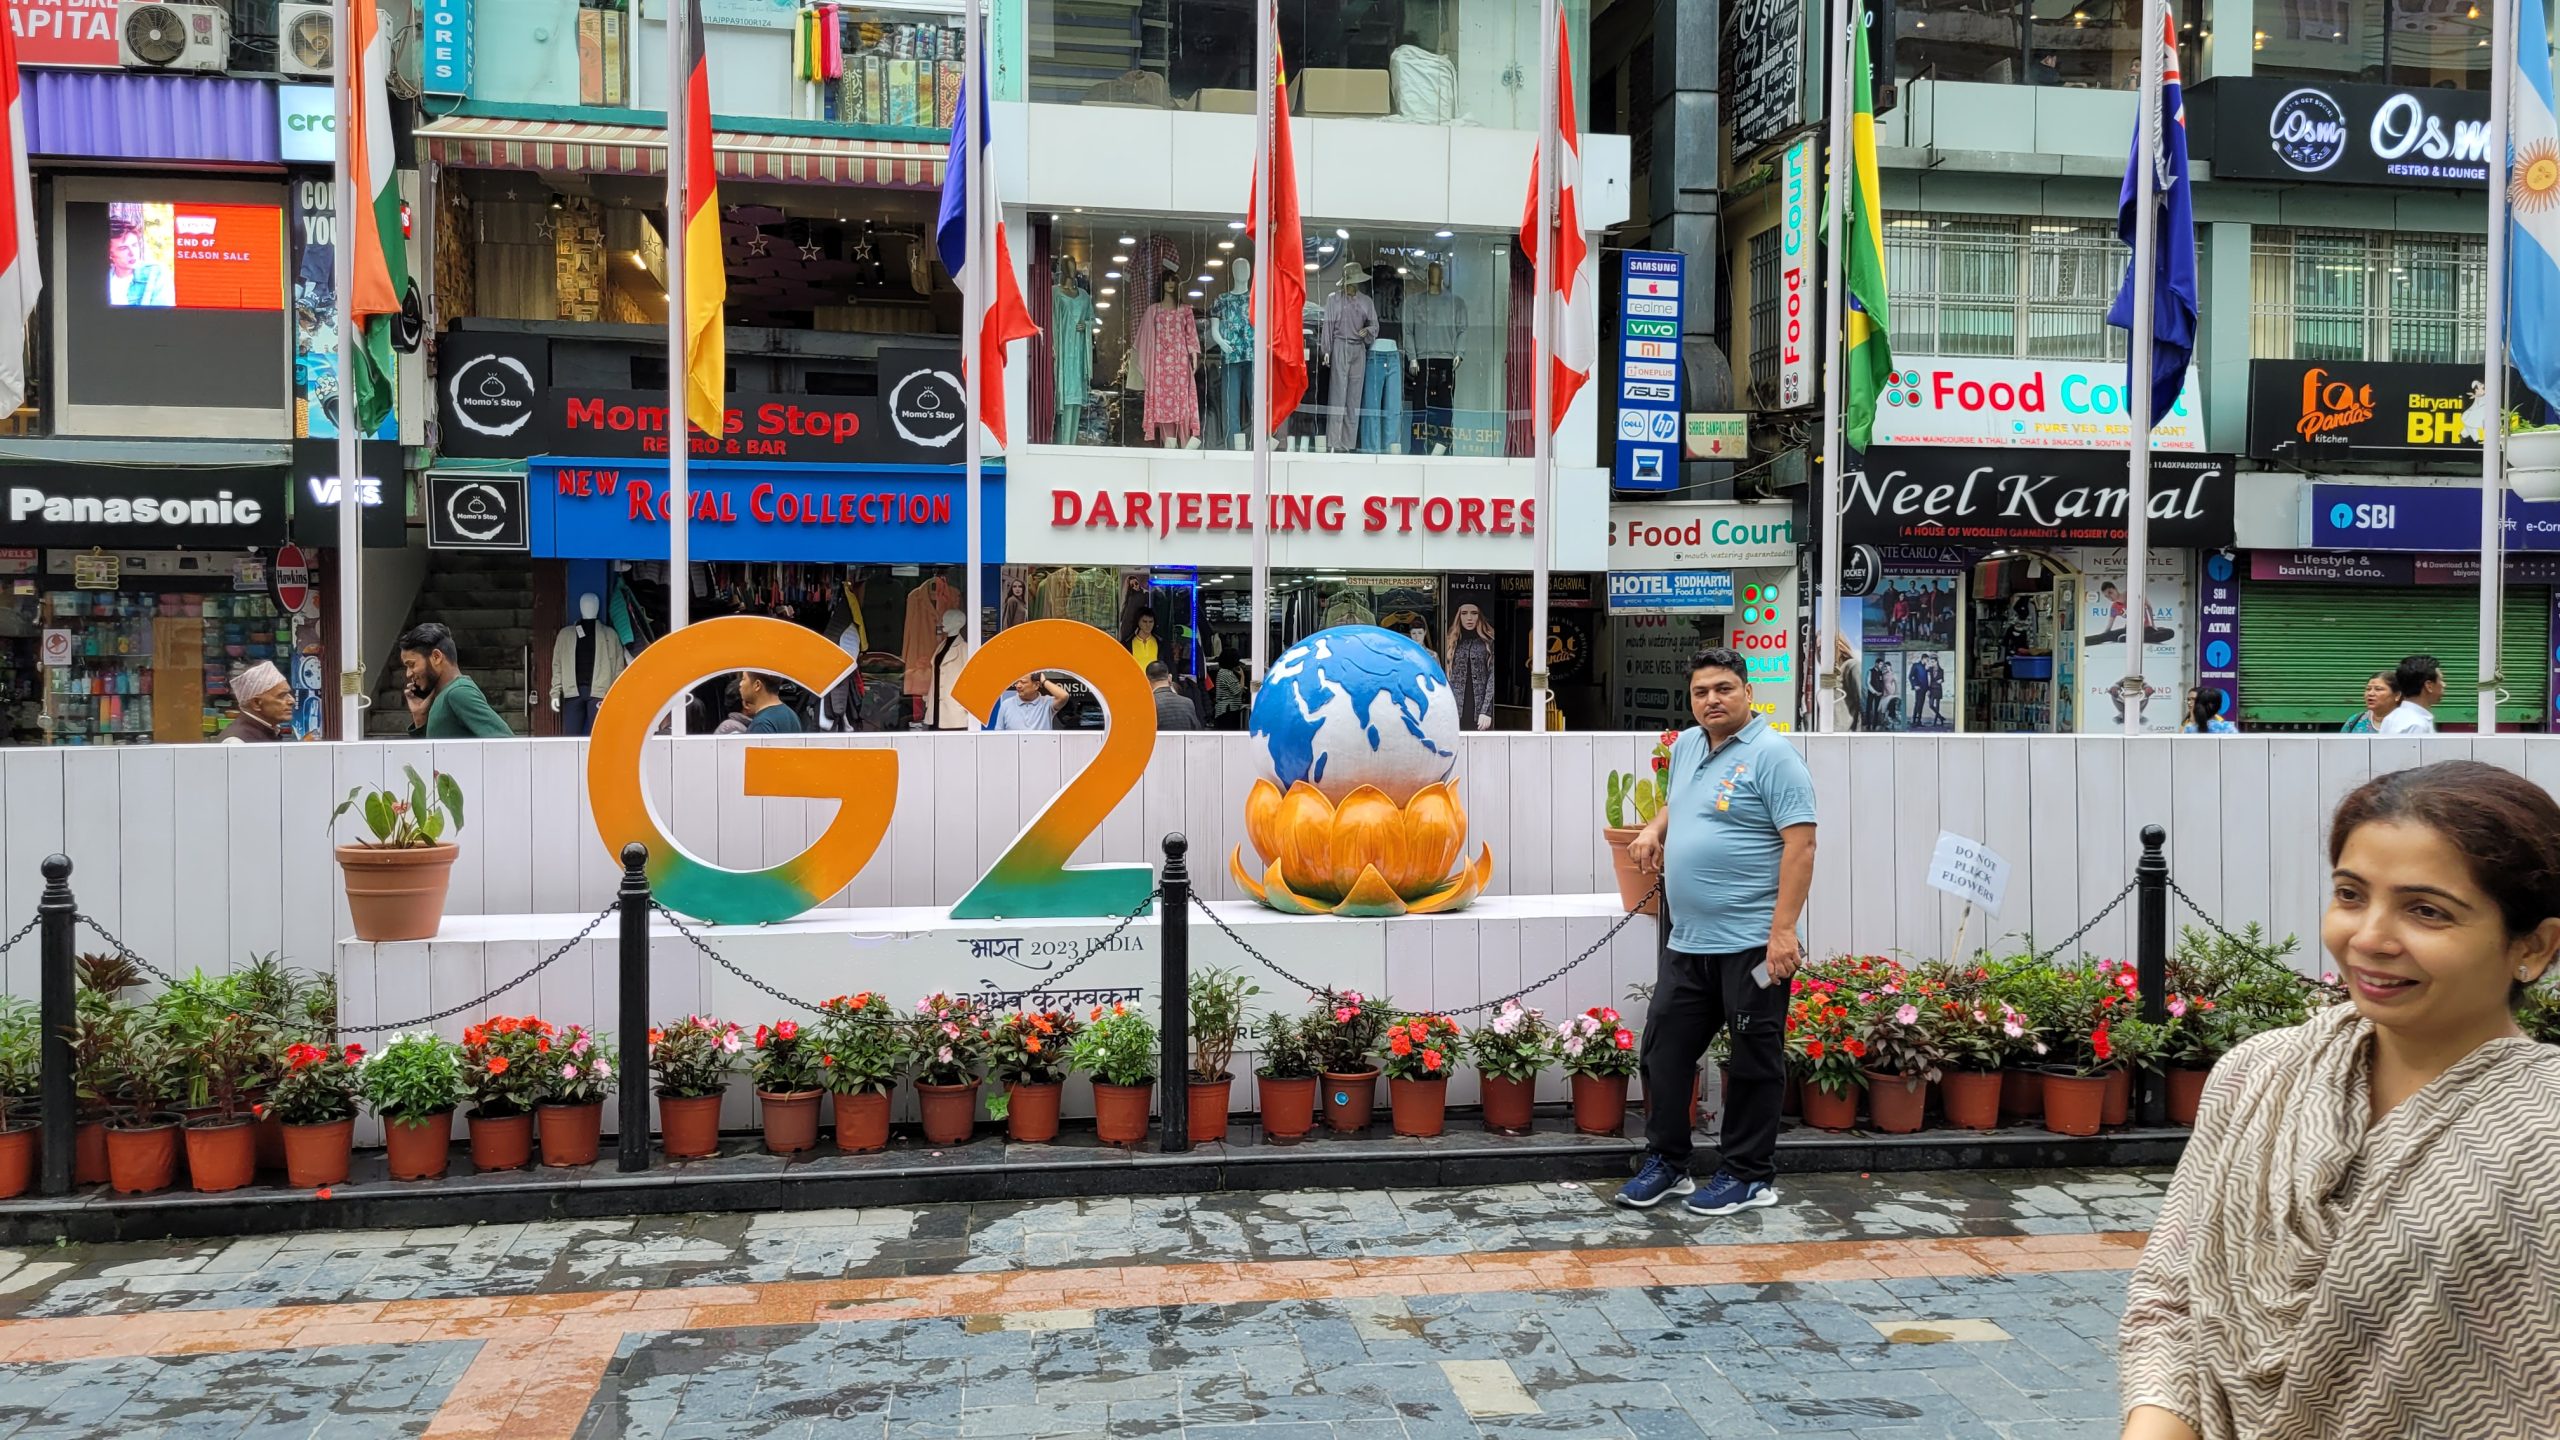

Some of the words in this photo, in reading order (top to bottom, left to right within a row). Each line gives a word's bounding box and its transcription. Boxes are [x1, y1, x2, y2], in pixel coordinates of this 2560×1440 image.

[10, 9, 119, 40] APITA
[194, 34, 211, 46] LG
[2388, 164, 2429, 176] RESTRO
[2431, 166, 2440, 177] &
[2443, 167, 2486, 180] LOUNGE
[1784, 141, 1803, 256] Court
[176, 238, 195, 247] END
[201, 238, 215, 247] OF
[176, 251, 219, 261] SEASON
[223, 252, 250, 261] SALE
[1630, 261, 1677, 273] SAMSUNG
[1630, 301, 1673, 315] realme
[1783, 266, 1801, 366] Food
[1638, 369, 1673, 377] ONEPLUS
[1626, 386, 1671, 398] ASUS
[1932, 371, 2045, 413] Food
[2060, 373, 2188, 417] Cot
[464, 397, 500, 407] Momo's
[500, 398, 522, 409] Stop
[2408, 393, 2463, 413] Biryani
[566, 397, 745, 435] Moms
[757, 402, 860, 444] Stop
[901, 409, 935, 421] Momo's
[935, 410, 956, 422] Stop
[1624, 420, 1643, 428] DELL
[1654, 414, 1674, 438] hp
[1688, 420, 1705, 437] SHREE
[1706, 421, 1727, 437] GANPATI
[1728, 421, 1746, 437] HOTEL
[2034, 422, 2069, 434] PURE
[2072, 423, 2099, 435] VEG.
[2105, 424, 2187, 437] RESRANT
[643, 435, 719, 456] RERO
[726, 438, 741, 456] &
[747, 440, 787, 456] BAR
[1894, 435, 1920, 444] INDIAN
[1922, 436, 1976, 445] MAINCOURSE
[1985, 437, 2008, 445] THALI
[2020, 438, 2041, 446] CHAT
[2051, 439, 2085, 447] SNACKS
[2095, 440, 2121, 448] SOUTH
[2161, 441, 2195, 450] CHINESE
[2315, 434, 2349, 444] kitchen
[558, 469, 620, 498] NEW
[750, 482, 952, 524] COLLECTION
[1837, 466, 1993, 518] Neel
[1998, 470, 2221, 527] Kamal
[11, 488, 262, 525] Panasonic
[483, 513, 498, 521] Stop
[1051, 489, 1347, 540] DARJEELING
[1363, 496, 1536, 535] STORES
[2355, 503, 2395, 529] SBI
[1628, 518, 1701, 547] Food
[1711, 519, 1793, 545] Court
[1905, 527, 1913, 537] A
[1914, 527, 1946, 538] HOUSE
[1947, 528, 1961, 538] OF
[1962, 528, 2006, 539] WOOLLEN
[2008, 529, 2058, 540] GARMENTS
[2060, 530, 2068, 539] &
[2070, 530, 2108, 540] HOSIERY
[2110, 530, 2130, 540] GOO
[1684, 551, 1708, 560] mouth
[1710, 550, 1744, 561] watering
[1876, 547, 1899, 559] NTE
[1901, 547, 1938, 559] CARLO
[2093, 557, 2174, 566] NEWCTLE
[2294, 554, 2356, 567] Lifestyle
[2360, 555, 2370, 566] &
[2429, 561, 2462, 569] Download
[277, 570, 307, 585] Hawkins
[1843, 568, 1866, 578] JOCKEY
[2279, 565, 2342, 578] banking,
[2345, 566, 2385, 578] dono.
[1451, 582, 1492, 590] NEWCASTLE
[1553, 577, 1587, 591] AGARWAL
[1611, 575, 1672, 594] HOTEL
[1674, 575, 1731, 588] SIDDHARTH
[1675, 588, 1695, 597] Food
[1695, 588, 1702, 596] &
[1704, 587, 1733, 597] Lodging
[2213, 588, 2226, 600] SBI
[2092, 607, 2109, 617] RU
[2151, 607, 2173, 617] LAX
[2203, 604, 2236, 615] e-Corner
[2208, 622, 2231, 633] ATM
[1648, 632, 1678, 652] watering
[1732, 629, 1787, 650] Food
[1635, 660, 1653, 674] PURE
[1655, 660, 1672, 675] VEG.
[1740, 653, 1790, 673] ourt
[1056, 683, 1092, 693] ONSU
[2091, 687, 2109, 695] PLA
[1636, 692, 1668, 704] BREAKFAST
[1955, 845, 1973, 859] DO
[1976, 853, 1998, 872] NOT
[1954, 860, 1992, 885] PLUCK
[1942, 870, 1994, 903] FLOWERS
[957, 937, 1050, 968] भारत
[1031, 941, 1079, 960] 2023
[1086, 936, 1143, 952] INDIA
